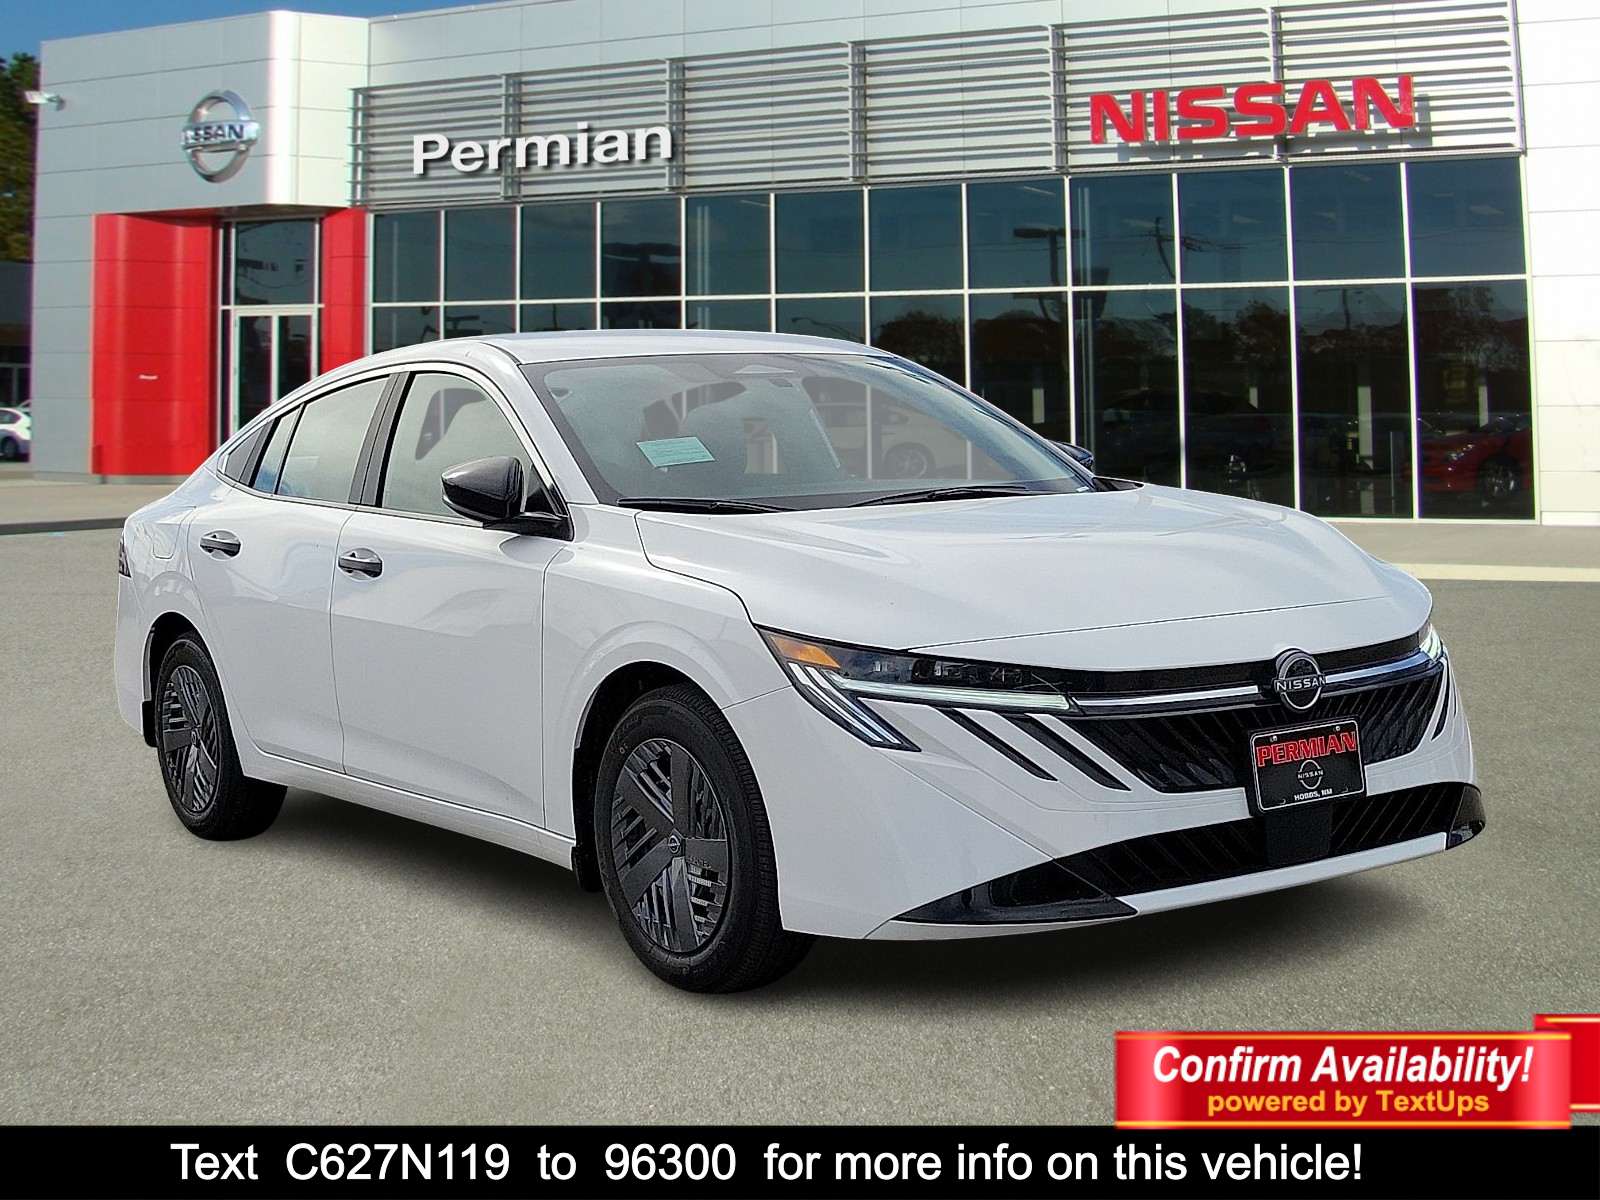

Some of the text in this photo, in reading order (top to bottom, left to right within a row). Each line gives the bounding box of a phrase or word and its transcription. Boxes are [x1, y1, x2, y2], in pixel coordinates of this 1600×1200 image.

[1090, 74, 1415, 144] NISSAN
[182, 124, 245, 143] SSAN
[413, 121, 672, 175] Permian
[1276, 676, 1326, 691] NISSAN
[1256, 731, 1357, 767] PERMIAN
[1297, 769, 1324, 779] NISSAN
[1321, 788, 1333, 796] NM
